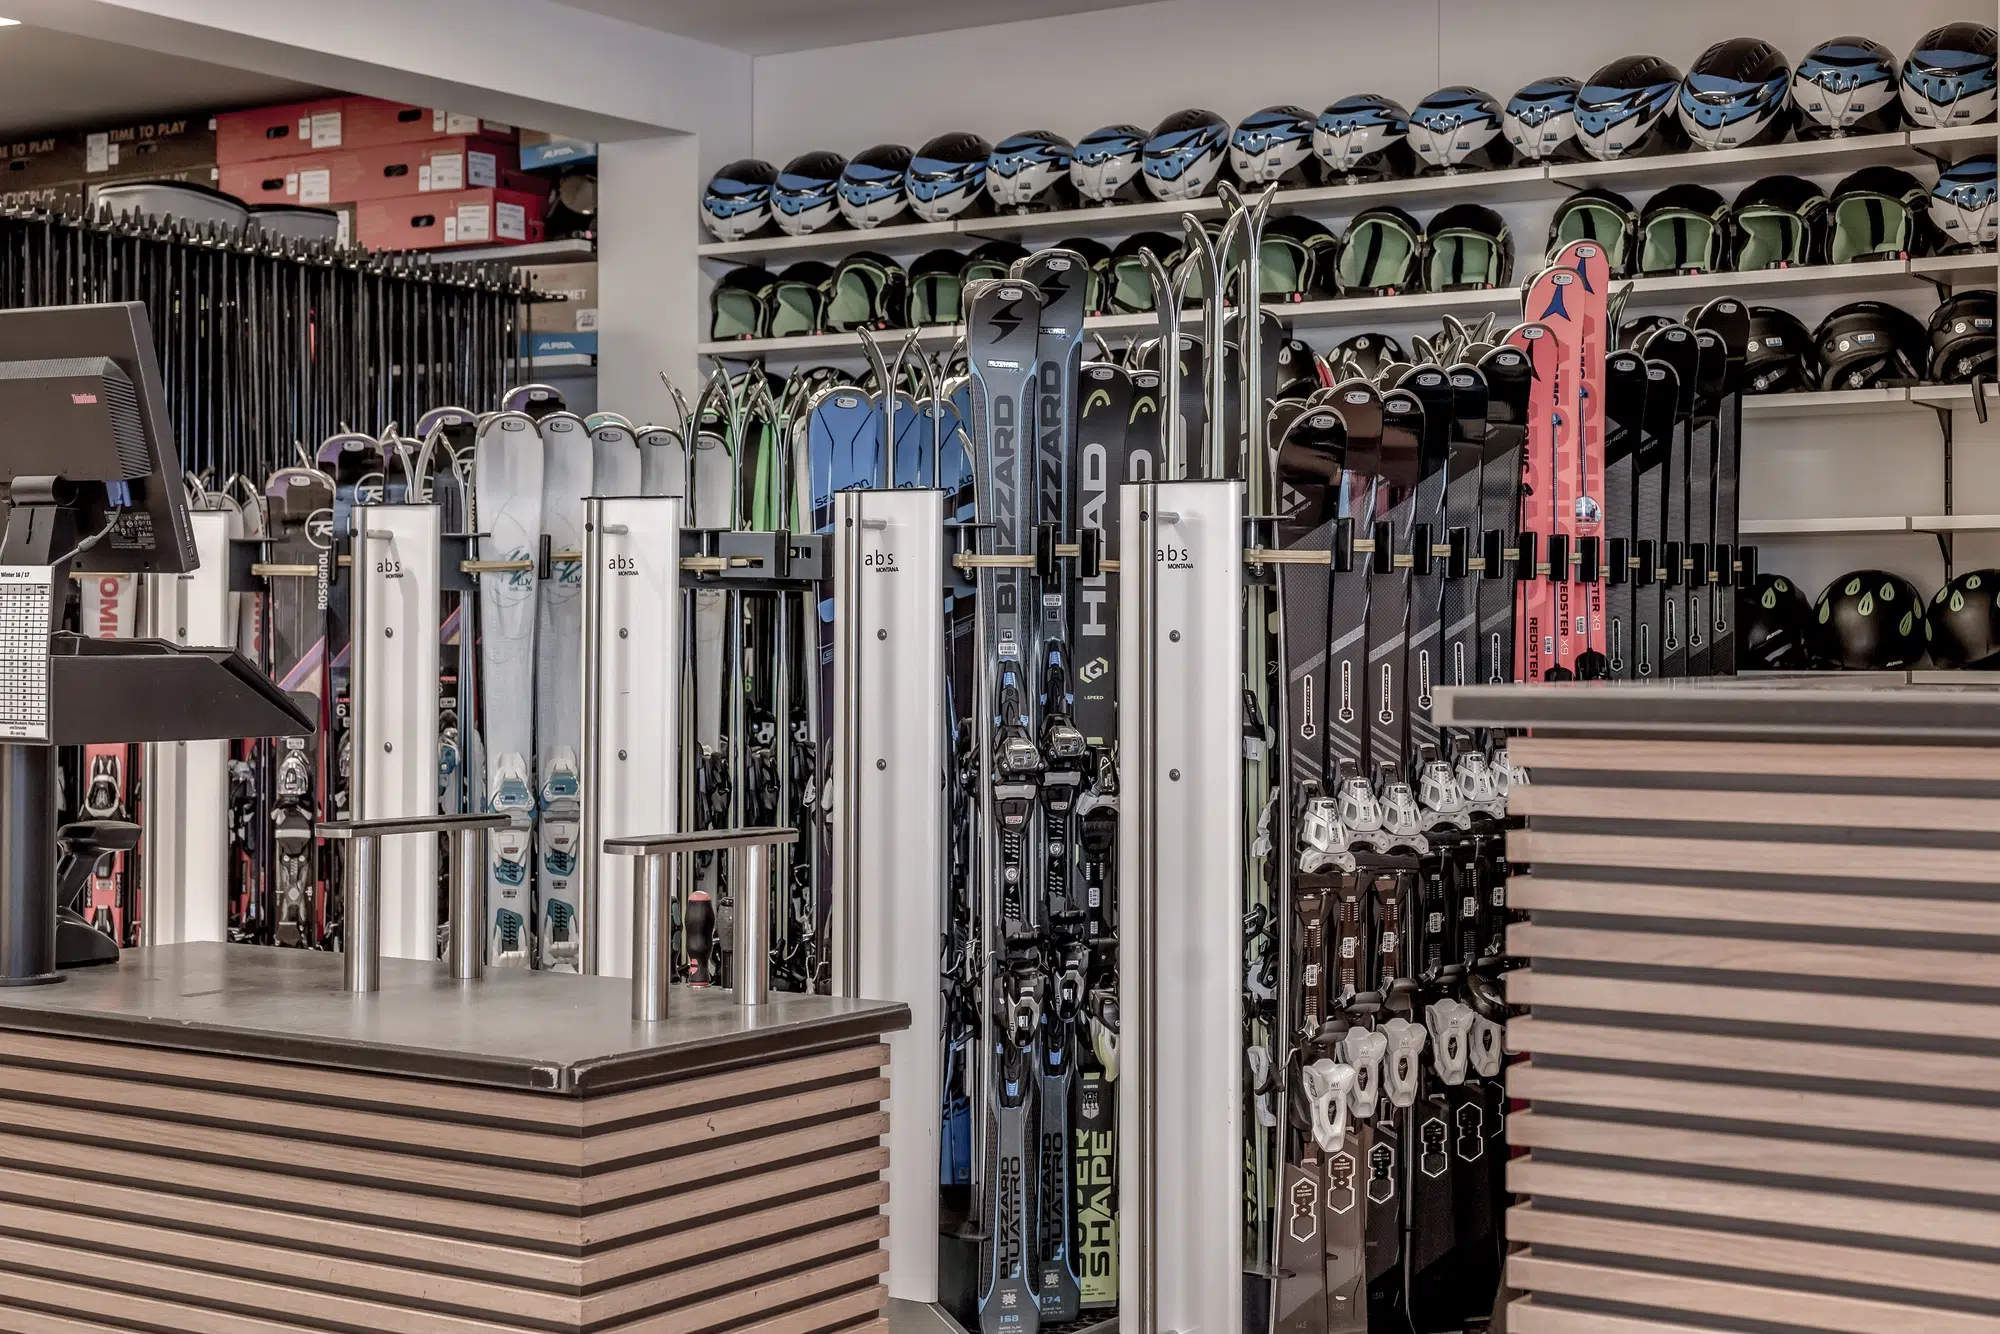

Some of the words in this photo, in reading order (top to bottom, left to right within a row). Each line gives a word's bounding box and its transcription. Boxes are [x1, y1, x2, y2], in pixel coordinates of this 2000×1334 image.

[110, 128, 134, 142] TIME
[139, 126, 154, 138] TO
[158, 120, 187, 134] PLAY
[12, 143, 26, 156] TO
[29, 138, 56, 153] PLAY
[1041, 360, 1063, 593] BZZARD
[608, 554, 635, 570] abs
[865, 550, 894, 566] abs
[1158, 545, 1188, 562] abs
[376, 558, 400, 572] abs
[100, 577, 119, 638] OMI
[1592, 614, 1601, 630] X9
[1530, 617, 1538, 678] REDSTER
[1560, 638, 1568, 655] X9
[336, 704, 346, 716] 6
[1042, 1132, 1052, 1262] BLIZZARD
[1090, 1130, 1112, 1277] SHAPE
[1000, 1156, 1010, 1280] BLIZZARD
[1042, 1296, 1061, 1304] 174
[1000, 1314, 1019, 1323] 168
